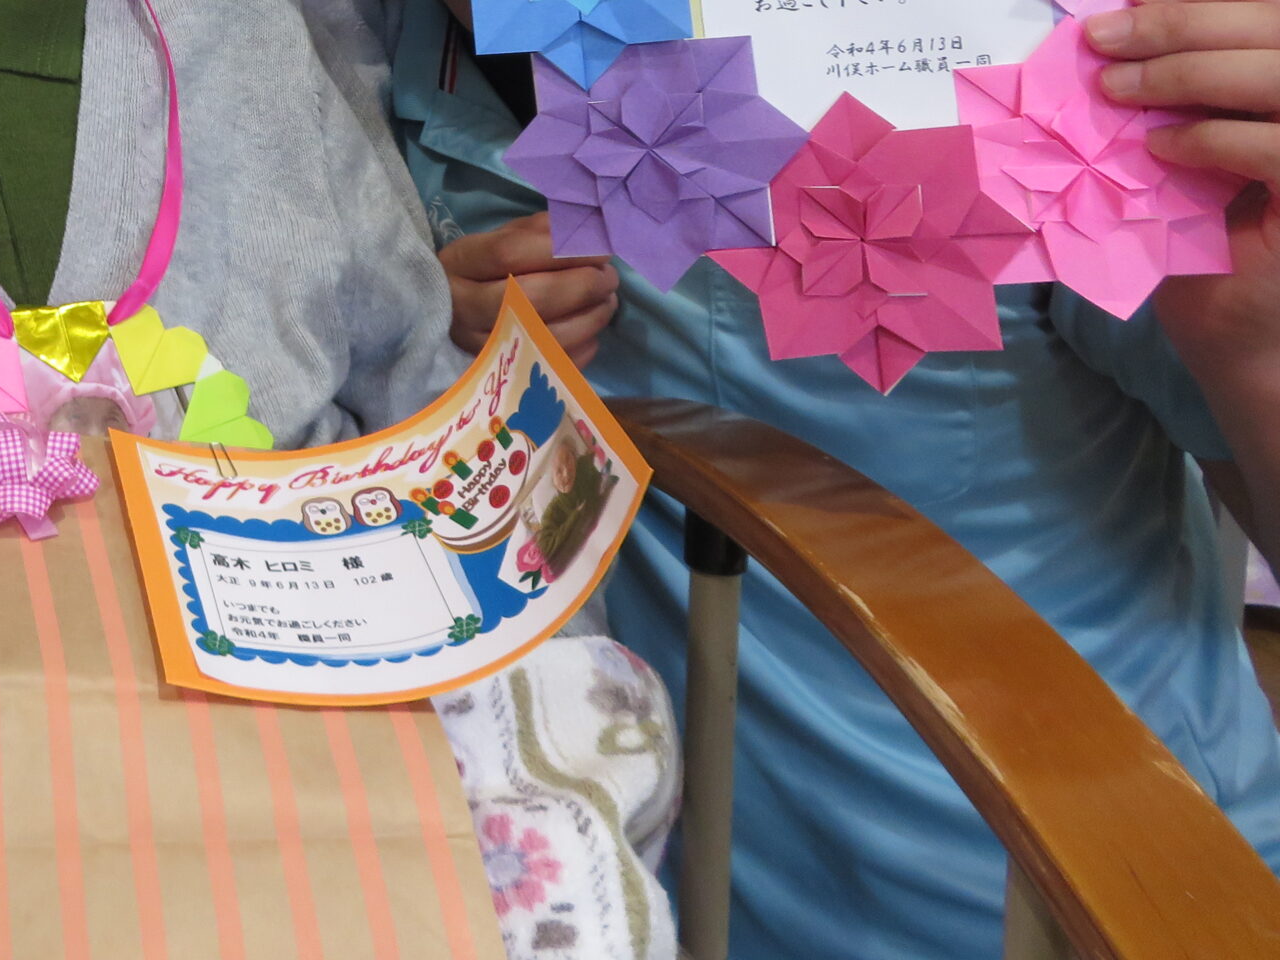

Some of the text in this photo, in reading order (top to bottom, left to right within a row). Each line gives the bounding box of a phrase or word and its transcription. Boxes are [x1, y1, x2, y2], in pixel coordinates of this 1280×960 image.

[825, 35, 964, 59] 令和4年6月13日
[154, 337, 519, 504] Happy Birthday to You
[457, 460, 493, 499] Happy
[461, 458, 507, 513] Birthday
[210, 552, 365, 573] 高木 ヒロミ 様
[223, 599, 281, 614] いつまでも
[228, 613, 368, 630] お元気でお過ごしください
[232, 627, 352, 643] 令和4年 職員一同
